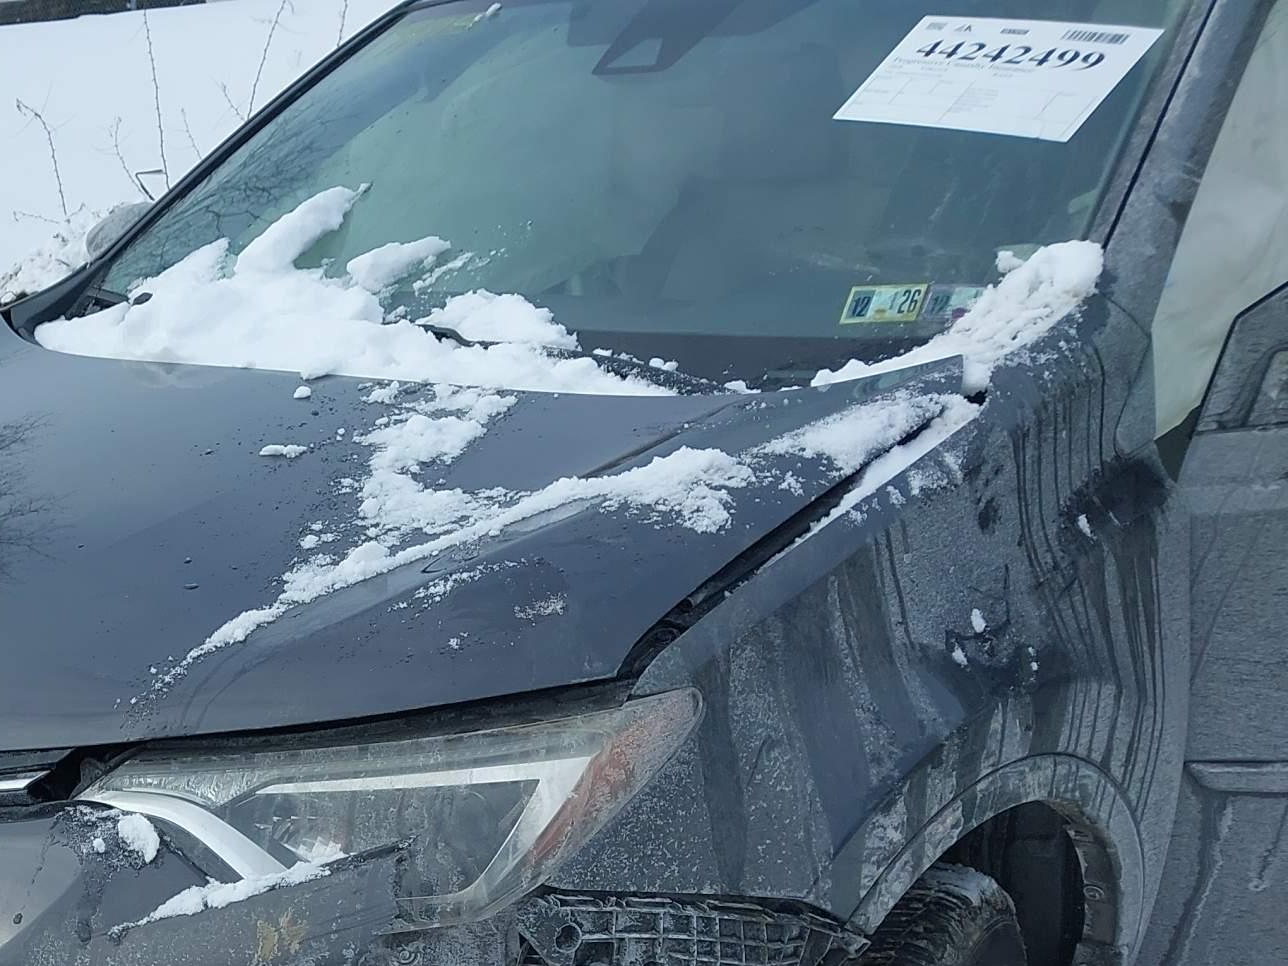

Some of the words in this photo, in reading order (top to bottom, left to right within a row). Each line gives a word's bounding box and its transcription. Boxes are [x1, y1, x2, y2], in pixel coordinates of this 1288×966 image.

[915, 39, 1105, 71] 44242499
[851, 296, 872, 317] 12
[897, 289, 922, 314] 26
